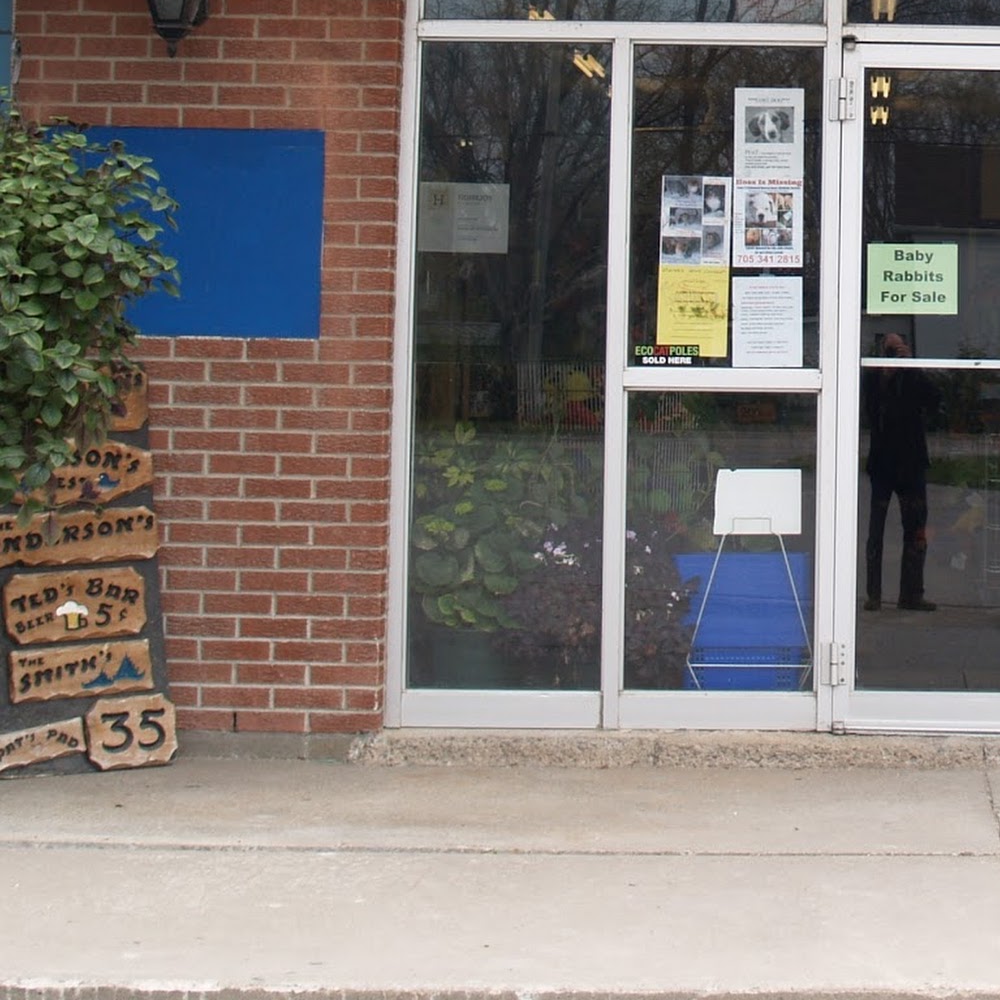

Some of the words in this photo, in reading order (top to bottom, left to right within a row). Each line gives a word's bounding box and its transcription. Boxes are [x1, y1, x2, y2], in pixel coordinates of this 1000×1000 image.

[738, 255, 754, 264] 705
[757, 255, 774, 264] 341
[777, 255, 801, 264] 2815
[894, 250, 934, 265] Baby
[883, 271, 944, 283] Rabbits
[881, 292, 907, 303] For
[912, 292, 946, 303] Sale
[642, 357, 666, 365] SOLD
[668, 357, 692, 365] HERE
[70, 450, 140, 473] SON'S
[2, 515, 154, 552] NDRSON'S
[10, 583, 74, 612] TED'S
[86, 578, 140, 605] BAR
[15, 612, 54, 634] BEER
[18, 657, 45, 667] THE
[19, 650, 112, 693] SMITH'S
[101, 708, 167, 753] 35
